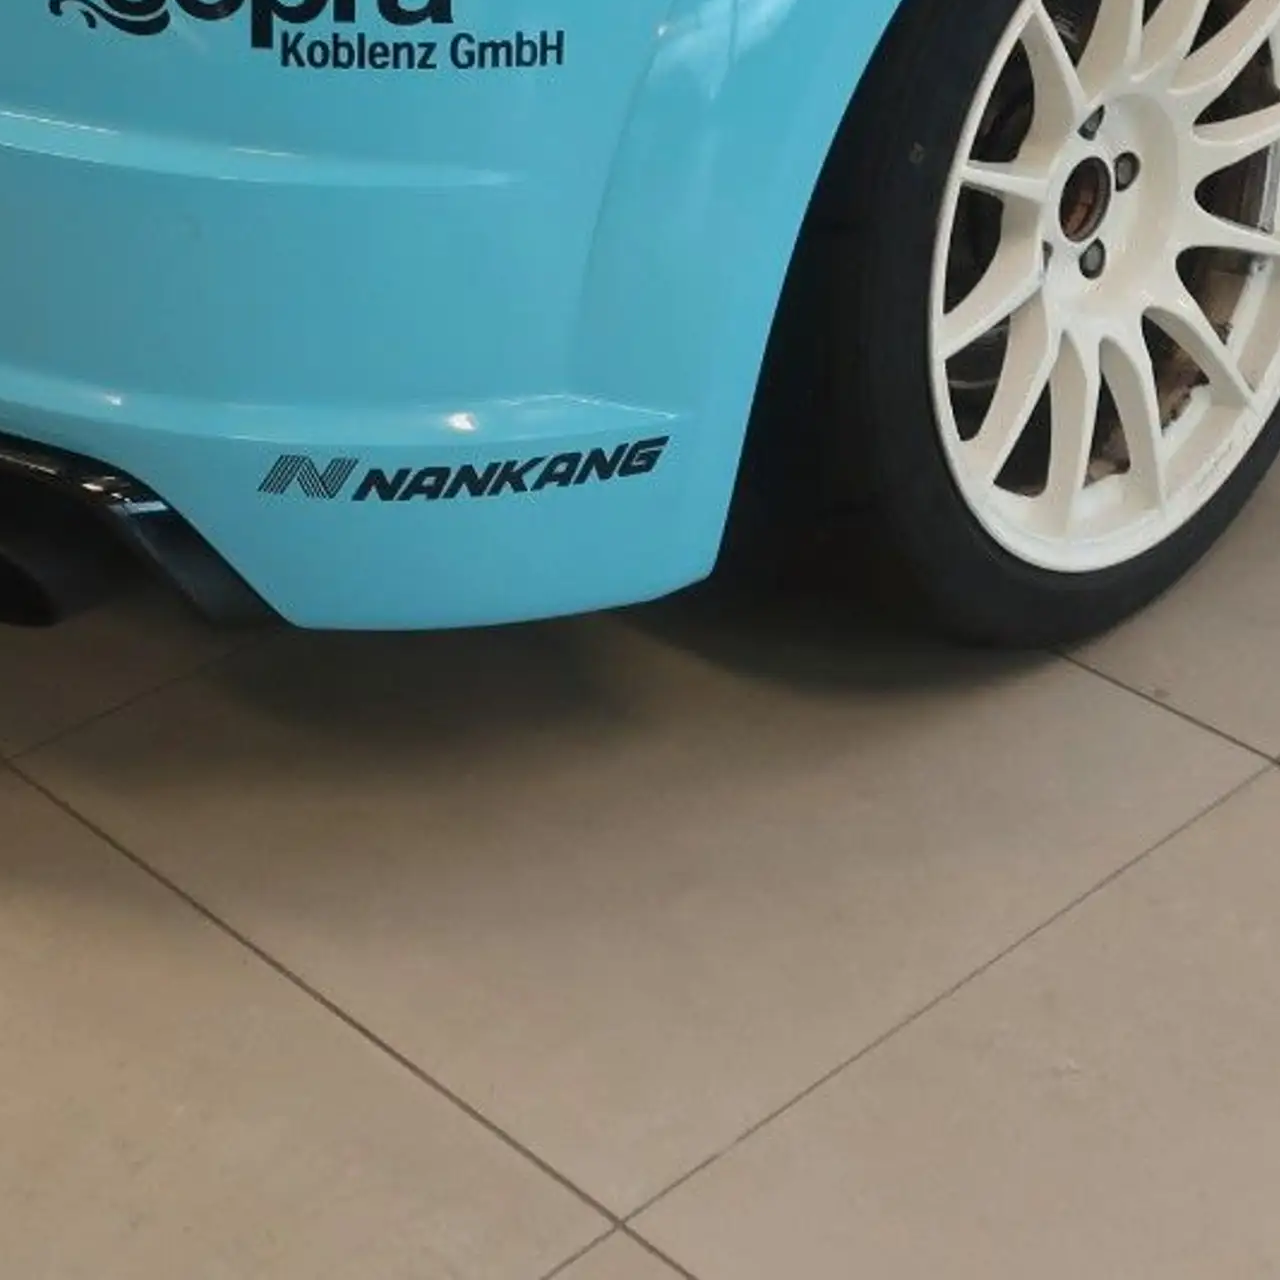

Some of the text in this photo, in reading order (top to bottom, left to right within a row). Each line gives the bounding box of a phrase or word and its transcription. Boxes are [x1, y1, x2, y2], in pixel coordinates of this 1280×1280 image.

[280, 30, 565, 70] Koblenz GmbH
[352, 435, 670, 502] NANKANG
